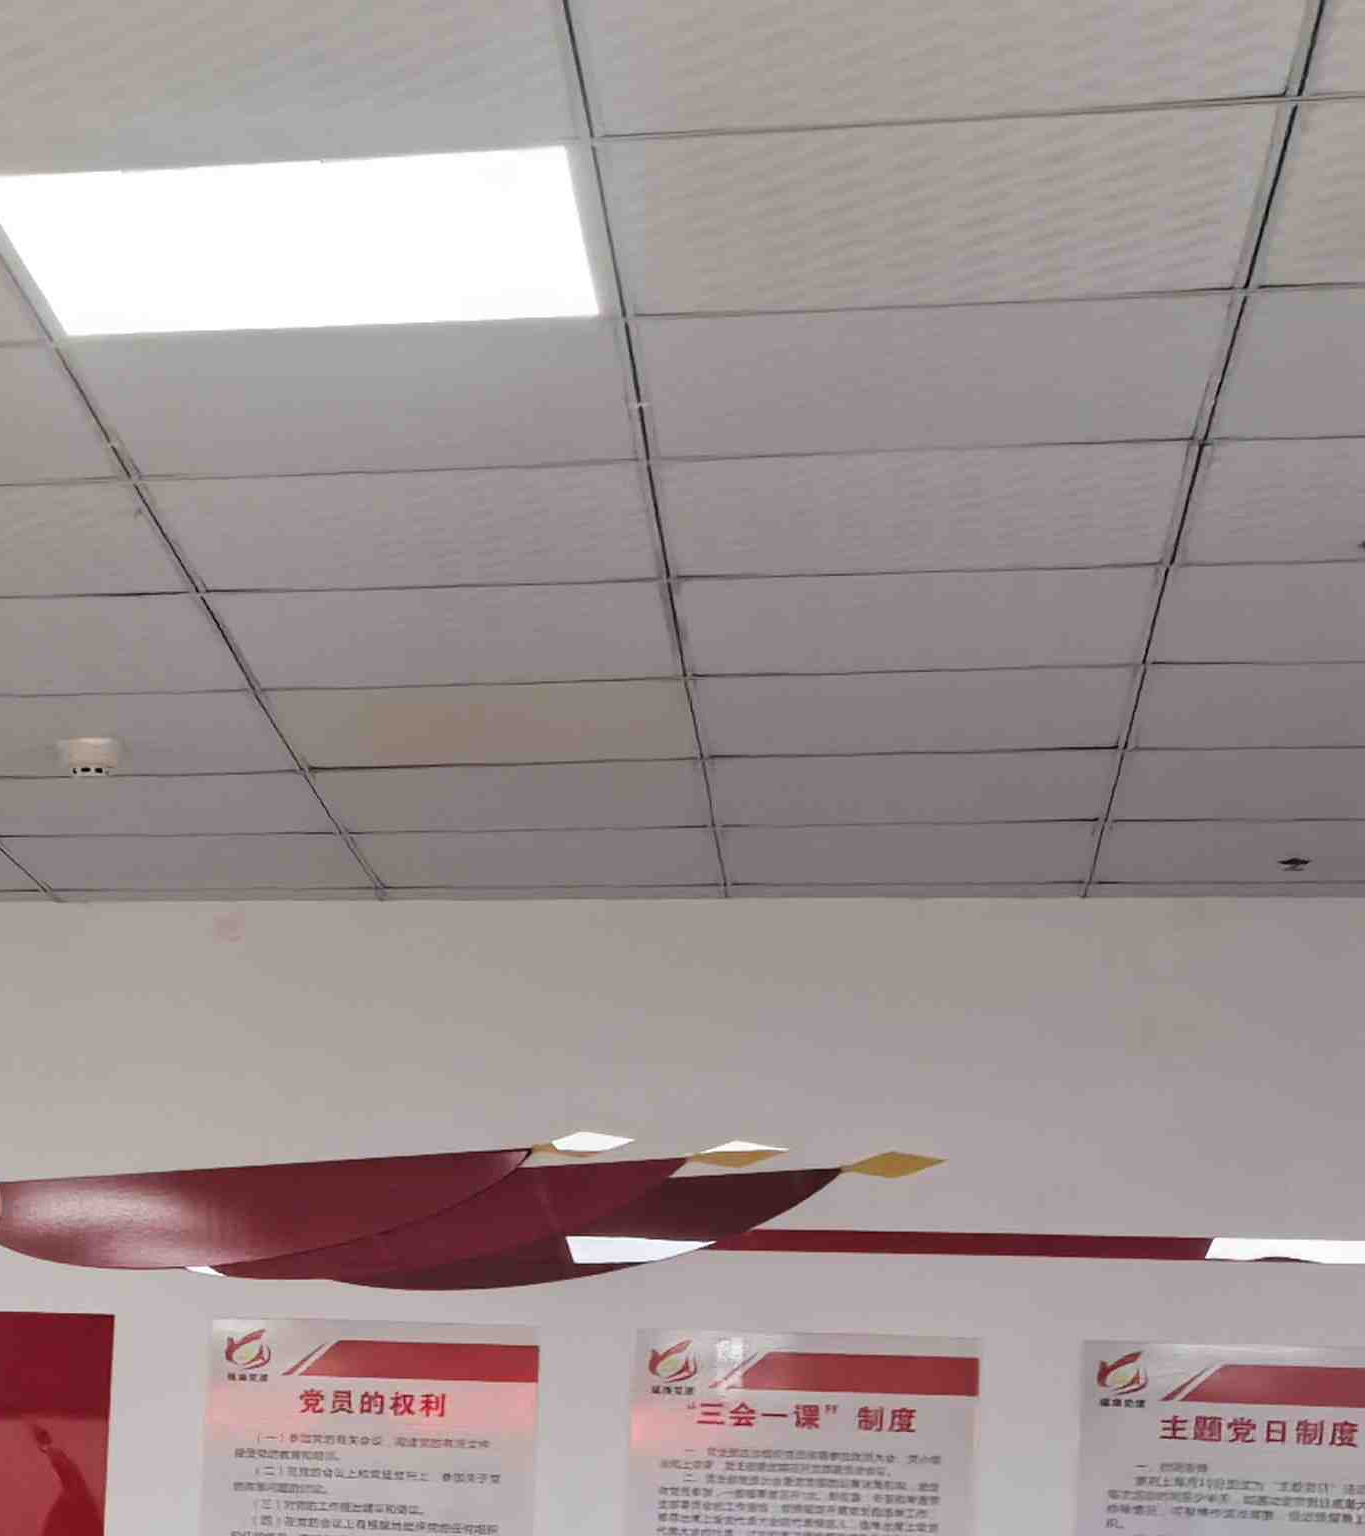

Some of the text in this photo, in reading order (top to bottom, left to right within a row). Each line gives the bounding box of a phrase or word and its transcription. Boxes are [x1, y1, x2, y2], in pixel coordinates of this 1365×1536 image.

[300, 1389, 446, 1417] 党员的权利
[1159, 1415, 1359, 1447] 主题党日制度
